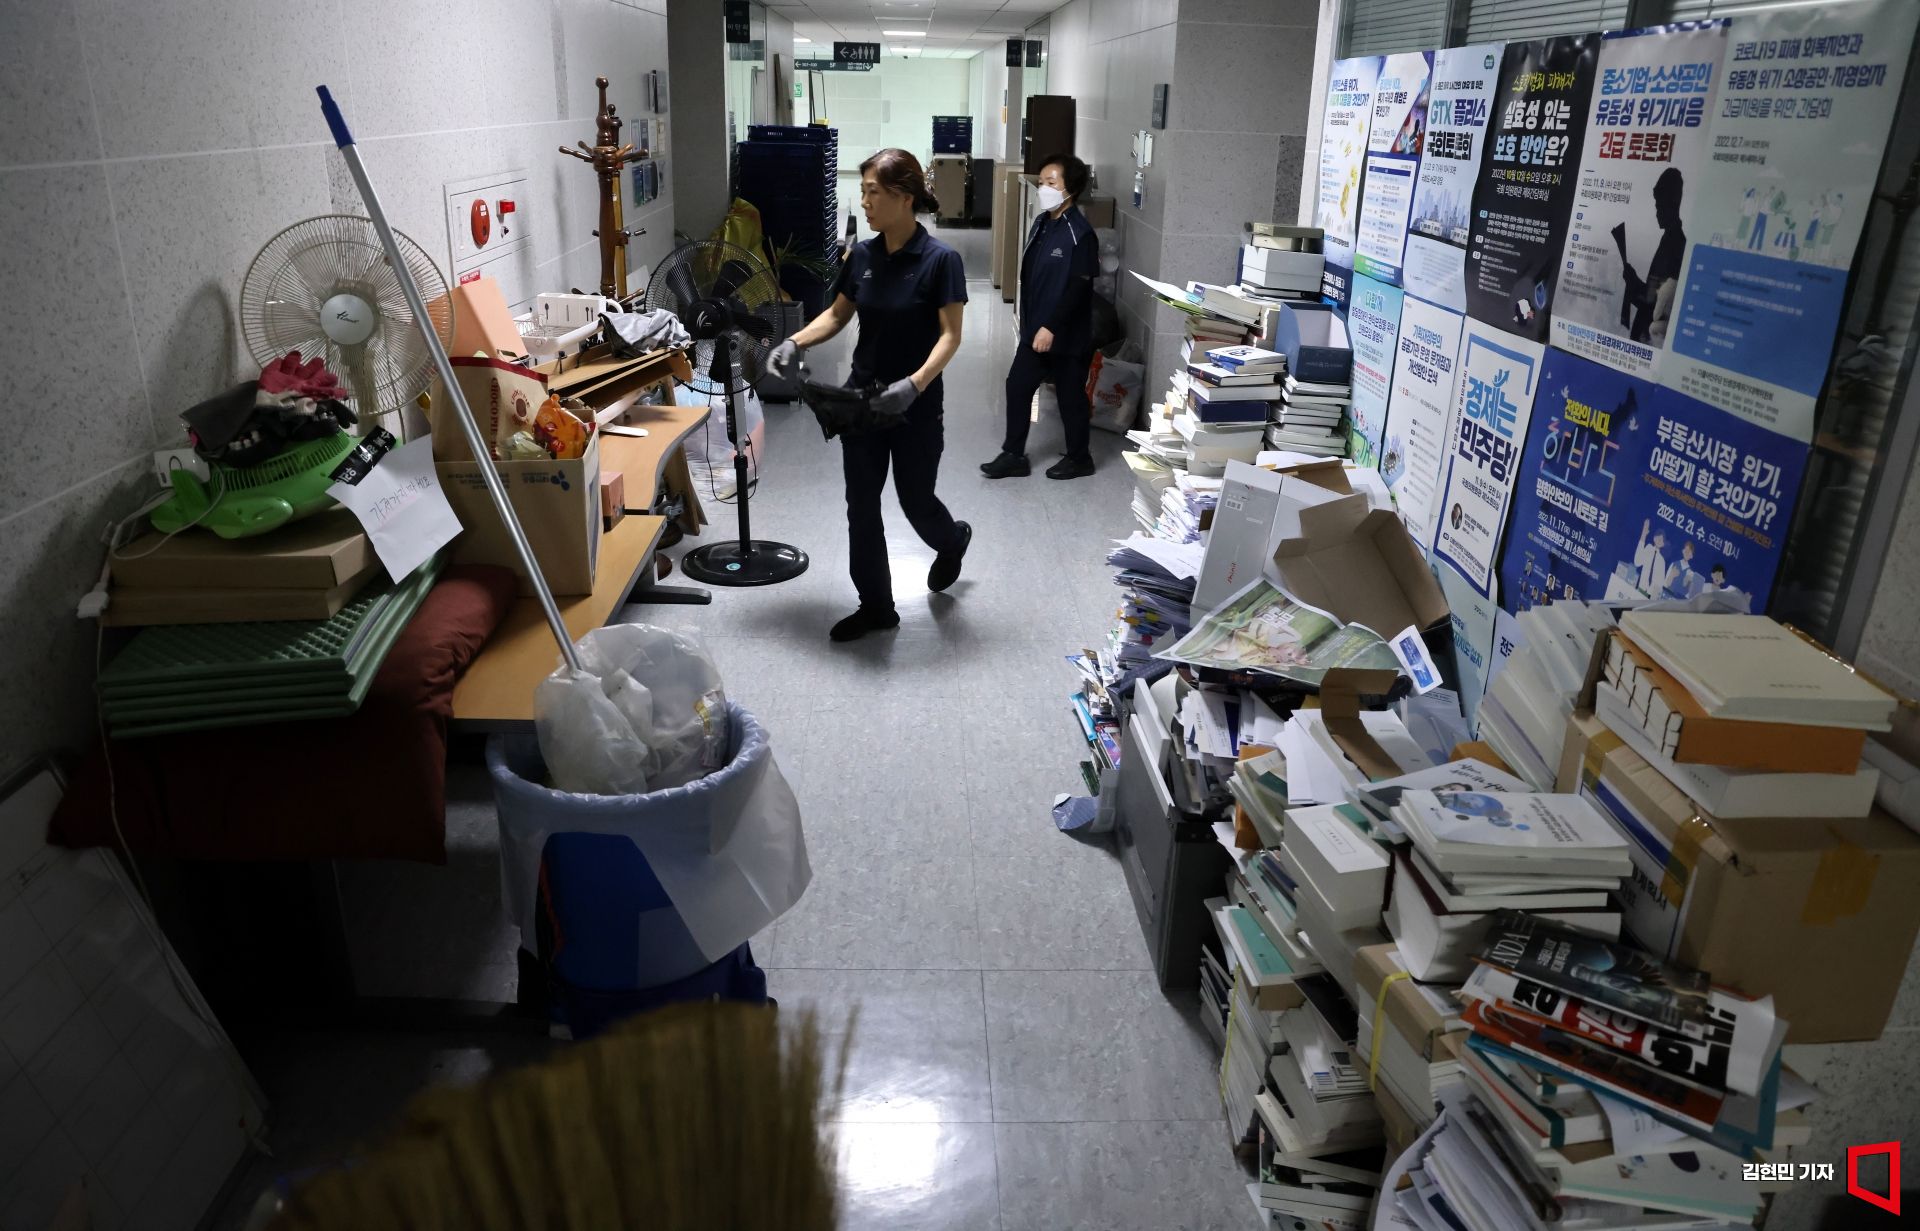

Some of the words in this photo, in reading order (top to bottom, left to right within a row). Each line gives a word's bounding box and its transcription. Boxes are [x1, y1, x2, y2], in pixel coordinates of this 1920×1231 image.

[1733, 40, 1775, 60] 코로나19
[1778, 39, 1801, 59] 피해
[1547, 72, 1575, 90] 피해자
[1601, 63, 1713, 95] 중소기업·소상공인
[1728, 71, 1757, 90] 유동성
[1758, 69, 1781, 88] 위기
[1783, 64, 1887, 88] 소상공인·자영업자
[1431, 101, 1453, 125] GTX
[1454, 99, 1486, 126] 플러스
[1503, 100, 1540, 130] 실효성
[1541, 99, 1571, 130] 있는
[1596, 99, 1635, 126] 유동성
[1638, 97, 1704, 128] 위기대응
[1722, 98, 1770, 118] 긴급지원을
[1772, 98, 1796, 118] 위한
[1796, 97, 1833, 118] 간담회
[1427, 131, 1473, 160] 국회토론회
[1493, 135, 1518, 161] 보호
[1520, 134, 1569, 166] 방안은?
[1599, 132, 1626, 158] 긴급
[1627, 133, 1676, 162] 토론회
[1541, 172, 1552, 183] 오후
[1401, 337, 1419, 358] 공공기관
[1420, 346, 1430, 363] 운영
[1430, 351, 1452, 374] 문제점과
[1408, 359, 1427, 380] 개선방안
[1427, 368, 1438, 387] 모색
[490, 377, 499, 433] CHOCOPIE
[1466, 376, 1518, 439] 경제는
[1459, 417, 1518, 486] 민주당!
[1657, 415, 1737, 475] 부동산시장
[1742, 455, 1782, 499] 위기,
[1650, 447, 1695, 490] 어떻게
[1695, 468, 1714, 499] 할
[1713, 477, 1777, 530] 것인가?
[1573, 498, 1598, 527] 새로운
[1598, 511, 1609, 533] 길
[1707, 533, 1723, 550] 오전
[1723, 541, 1740, 560] 10시
